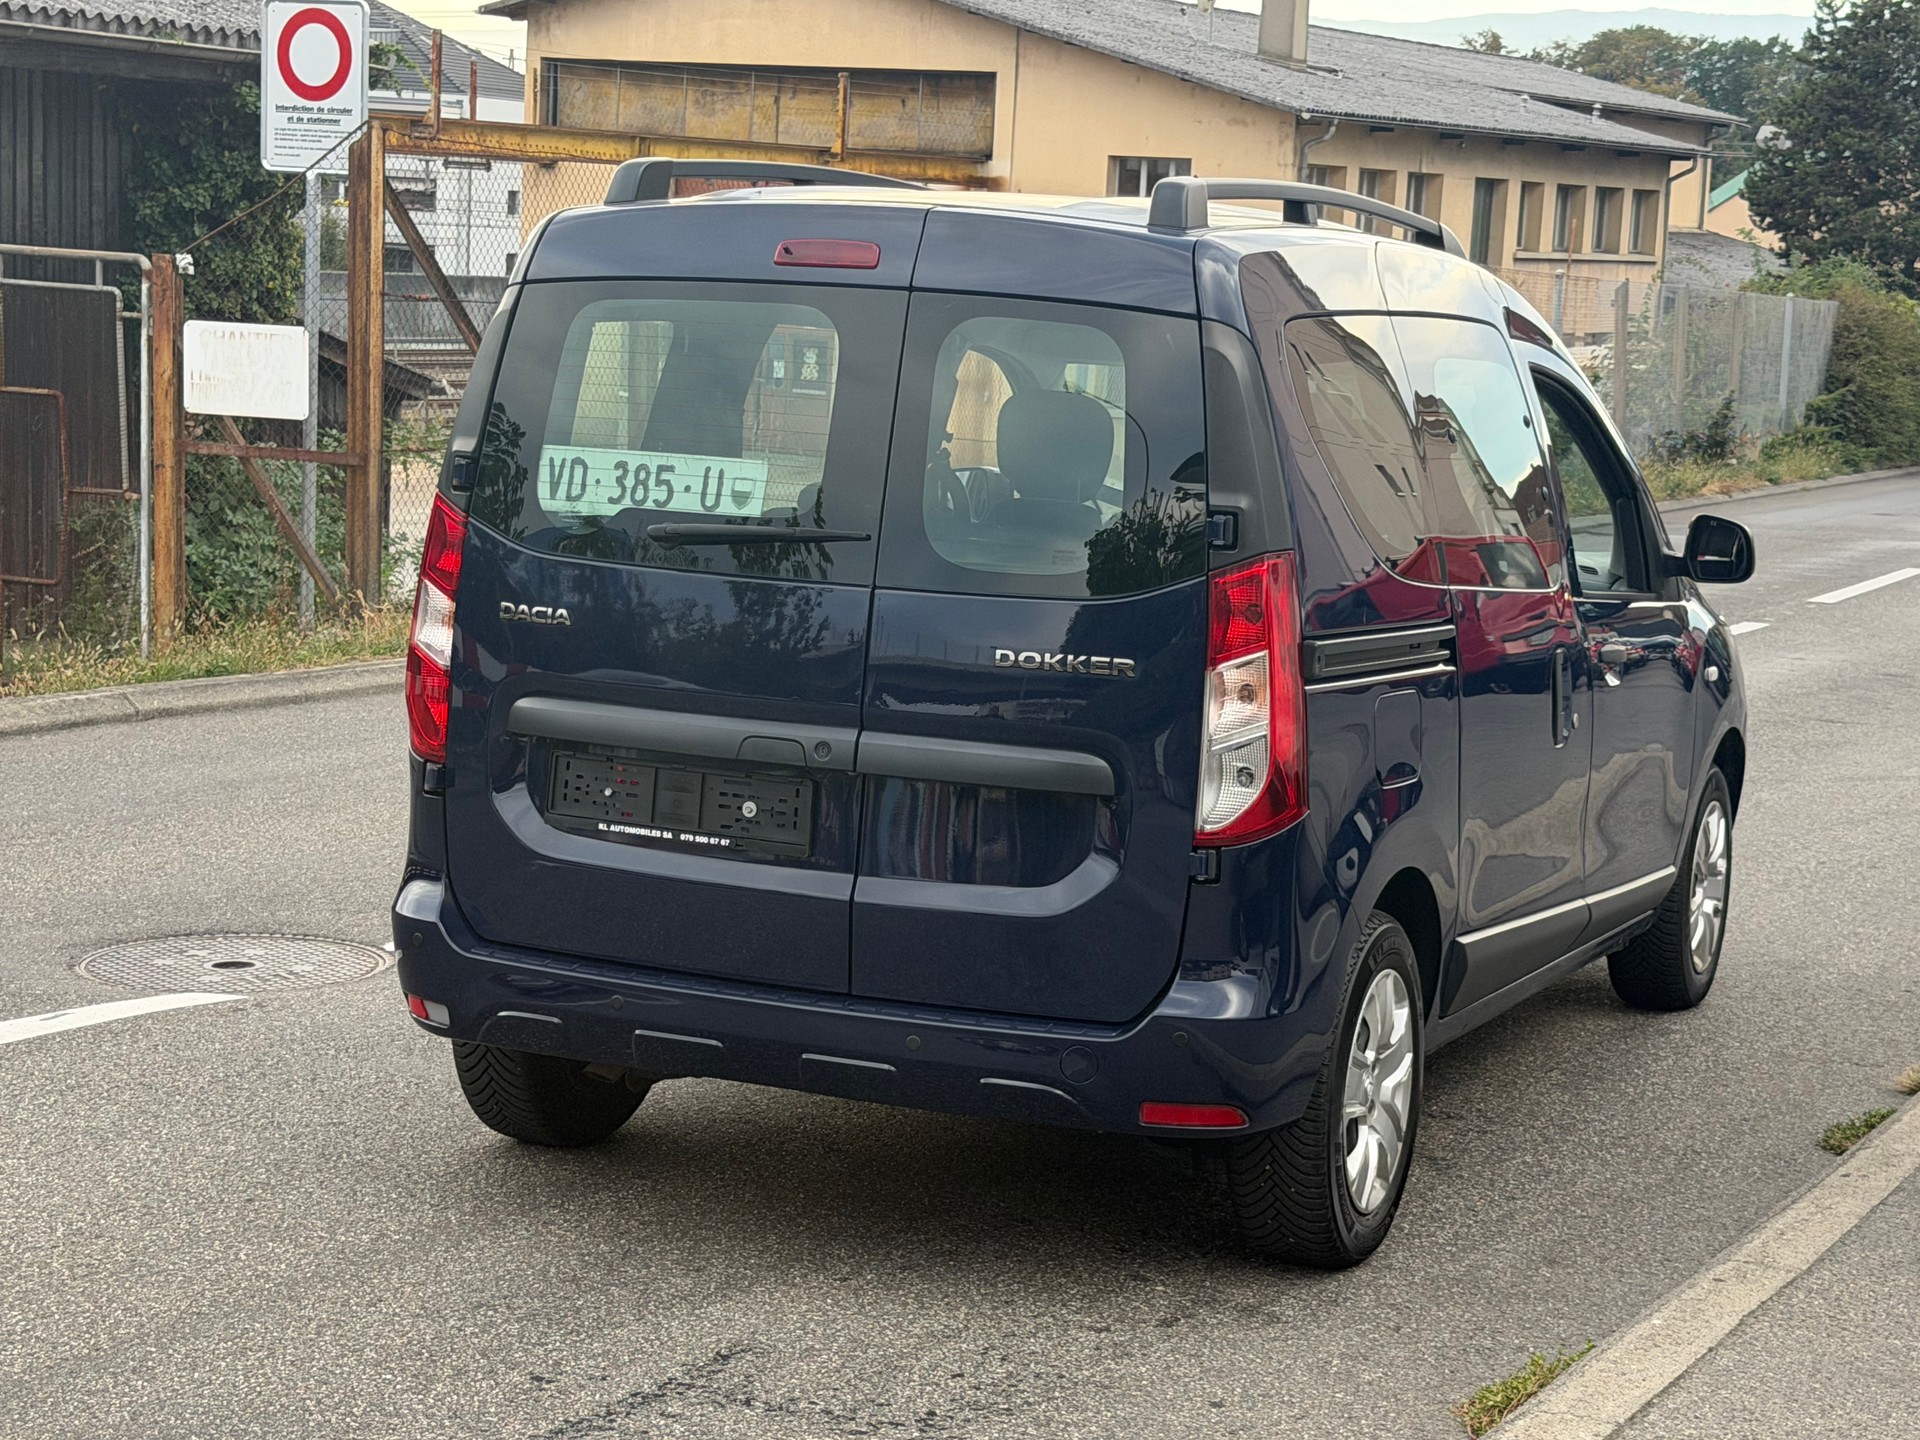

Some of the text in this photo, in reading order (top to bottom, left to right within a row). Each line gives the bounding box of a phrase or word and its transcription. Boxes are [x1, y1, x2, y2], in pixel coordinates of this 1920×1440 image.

[275, 104, 314, 112] Interdiction
[326, 106, 353, 114] circuler
[306, 117, 341, 125] stationner
[500, 601, 571, 626] DACIA
[995, 649, 1136, 677] DOKKER
[610, 824, 661, 837] AUTOMOBILES
[662, 831, 673, 839] SA
